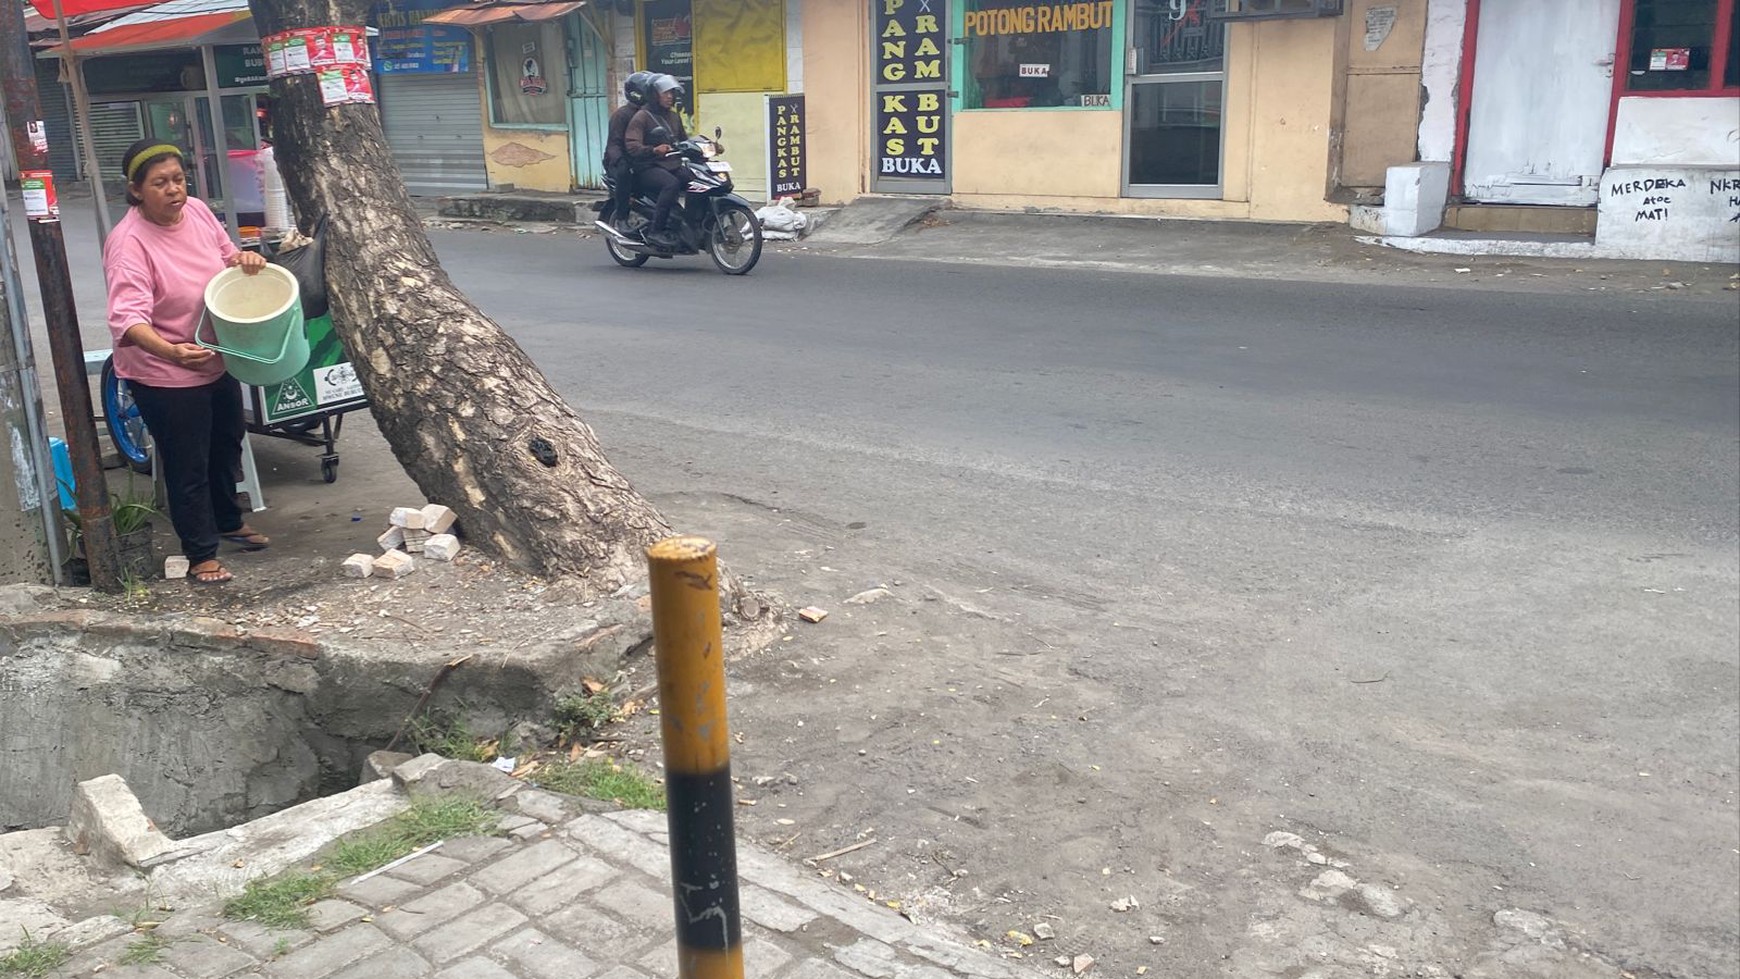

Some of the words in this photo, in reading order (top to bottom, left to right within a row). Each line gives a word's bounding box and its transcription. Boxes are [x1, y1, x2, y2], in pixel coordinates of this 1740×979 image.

[965, 8, 1035, 36] POTONG
[1038, 1, 1113, 32] RAMBUT
[1021, 67, 1047, 76] BUKA
[777, 106, 787, 178] PANGKAS
[790, 115, 800, 176] RAMBUT
[882, 158, 942, 174] BUKA
[777, 182, 801, 192] BUKA
[1611, 178, 1686, 196] MERDEKA
[277, 398, 308, 411] ANSOR
